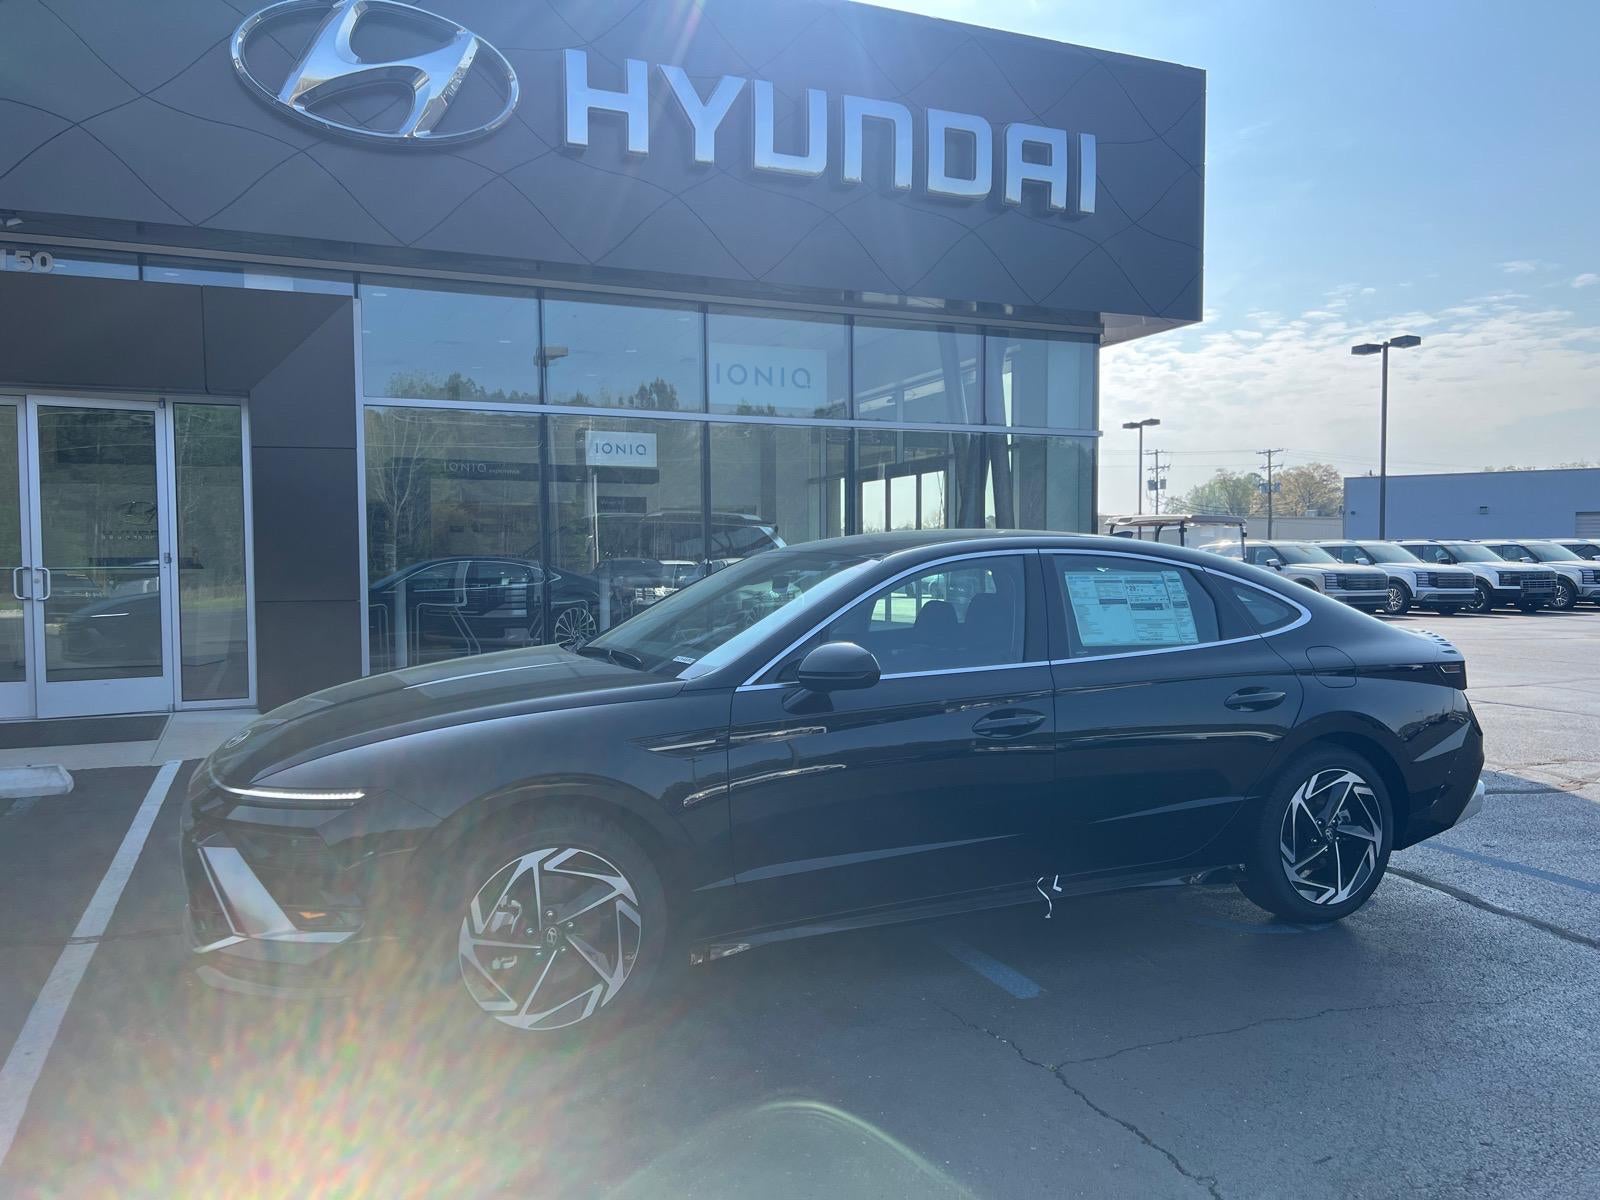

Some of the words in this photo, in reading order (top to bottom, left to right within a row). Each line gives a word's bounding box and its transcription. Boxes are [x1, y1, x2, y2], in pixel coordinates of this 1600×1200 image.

[564, 48, 1097, 214] HYUNDAI
[716, 363, 811, 389] IONIQ
[595, 442, 647, 456] IONIQ
